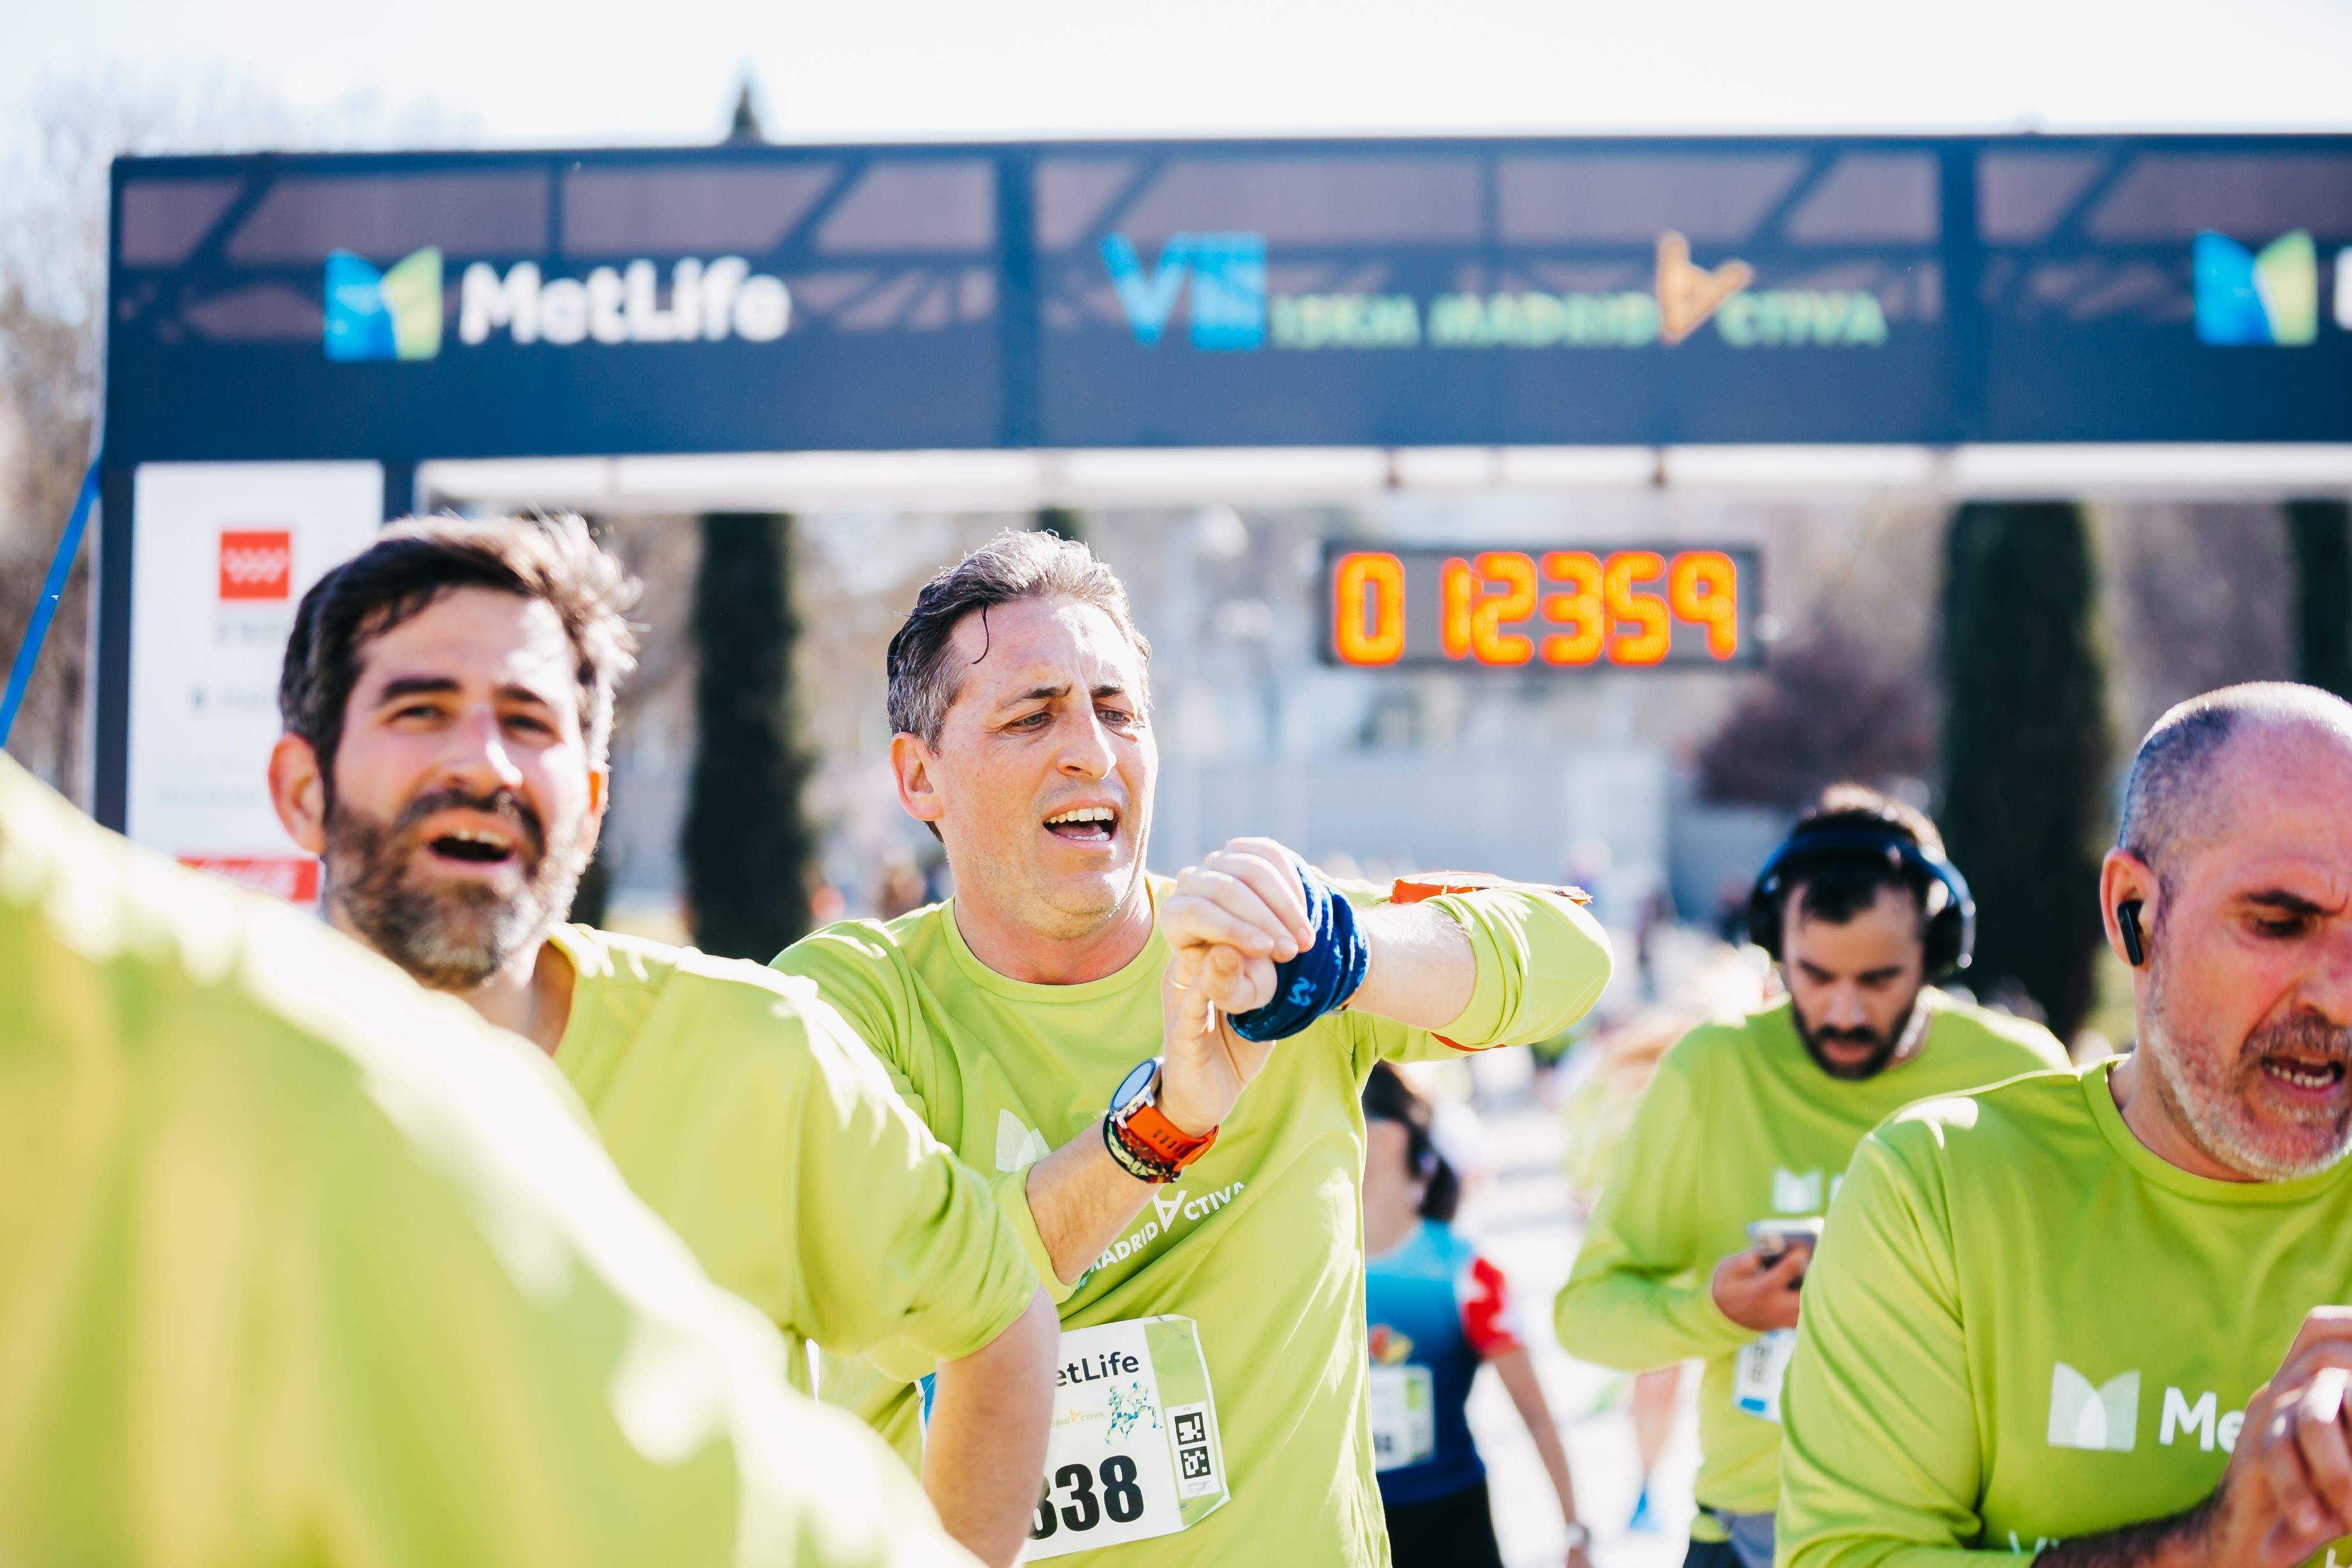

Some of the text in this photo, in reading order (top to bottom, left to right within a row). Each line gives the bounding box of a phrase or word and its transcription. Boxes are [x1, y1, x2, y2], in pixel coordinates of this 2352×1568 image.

[460, 255, 792, 344] MetLife
[1055, 1351, 1139, 1387] etLife
[2159, 1386, 2246, 1454] Me
